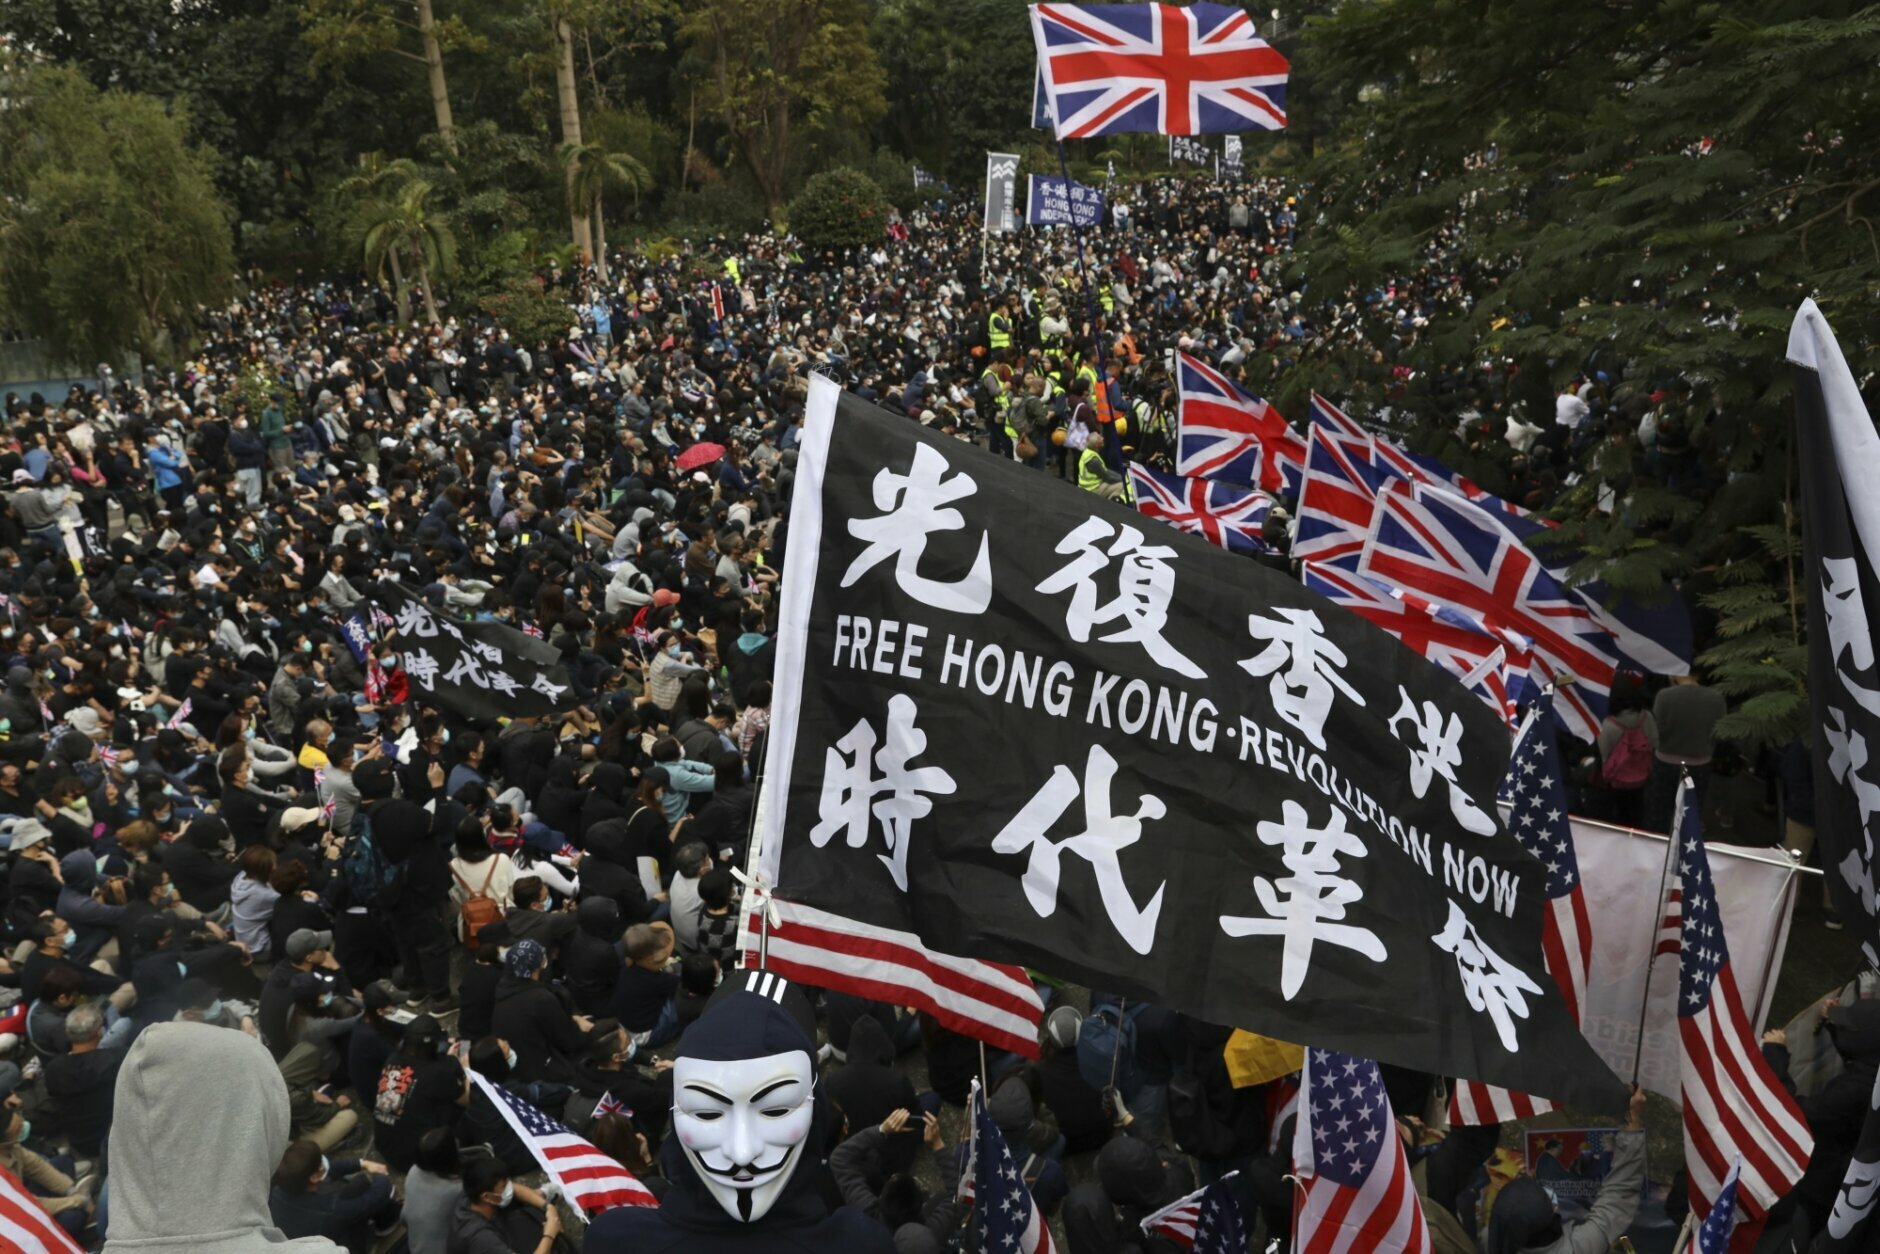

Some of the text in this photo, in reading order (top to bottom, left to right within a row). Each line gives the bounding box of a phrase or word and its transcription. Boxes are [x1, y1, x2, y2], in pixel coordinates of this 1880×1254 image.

[1044, 197, 1070, 211] HONG
[809, 693, 1544, 1053] 時代革命
[833, 614, 929, 679] FREE
[939, 633, 1076, 718] HONG
[1442, 841, 1521, 919] NOW
